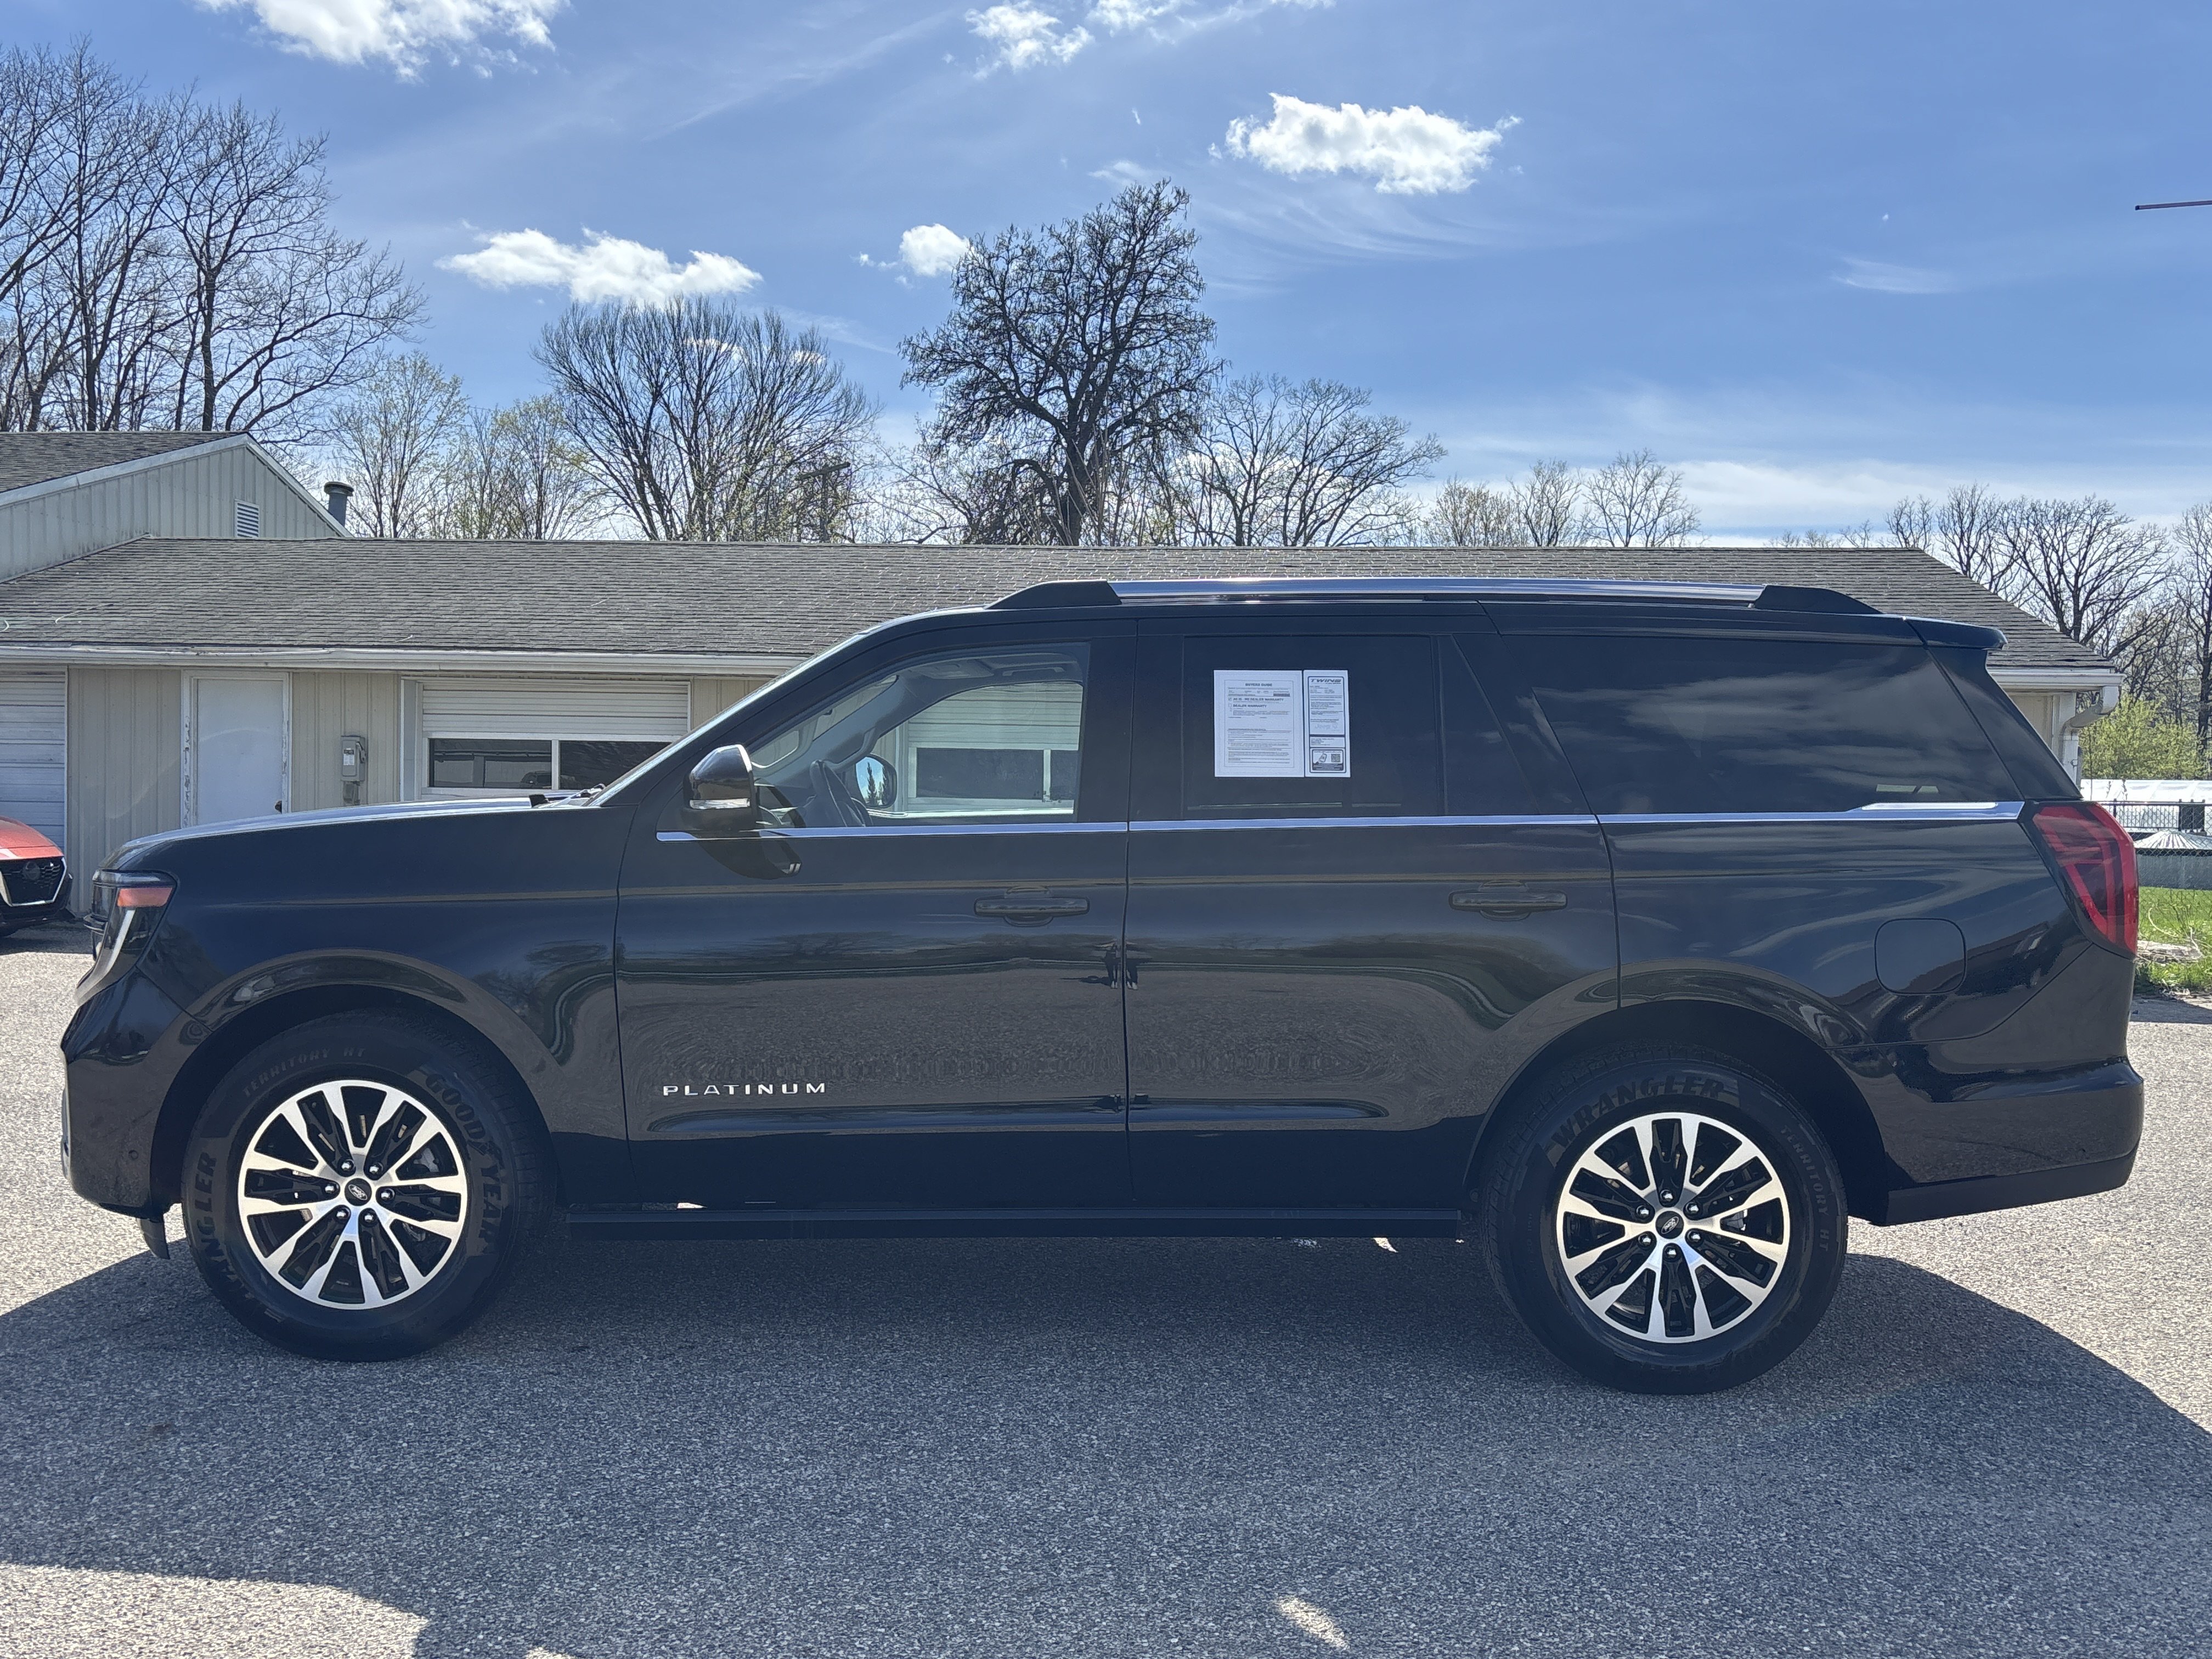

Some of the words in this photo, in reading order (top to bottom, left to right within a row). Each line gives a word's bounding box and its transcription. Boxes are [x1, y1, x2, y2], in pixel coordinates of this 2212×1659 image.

[242, 1047, 331, 1097] TERRITORY
[663, 1082, 825, 1096] PLATINUM
[1551, 1075, 1724, 1148] WRANGLER
[1780, 1125, 1830, 1216] TERRITORY
